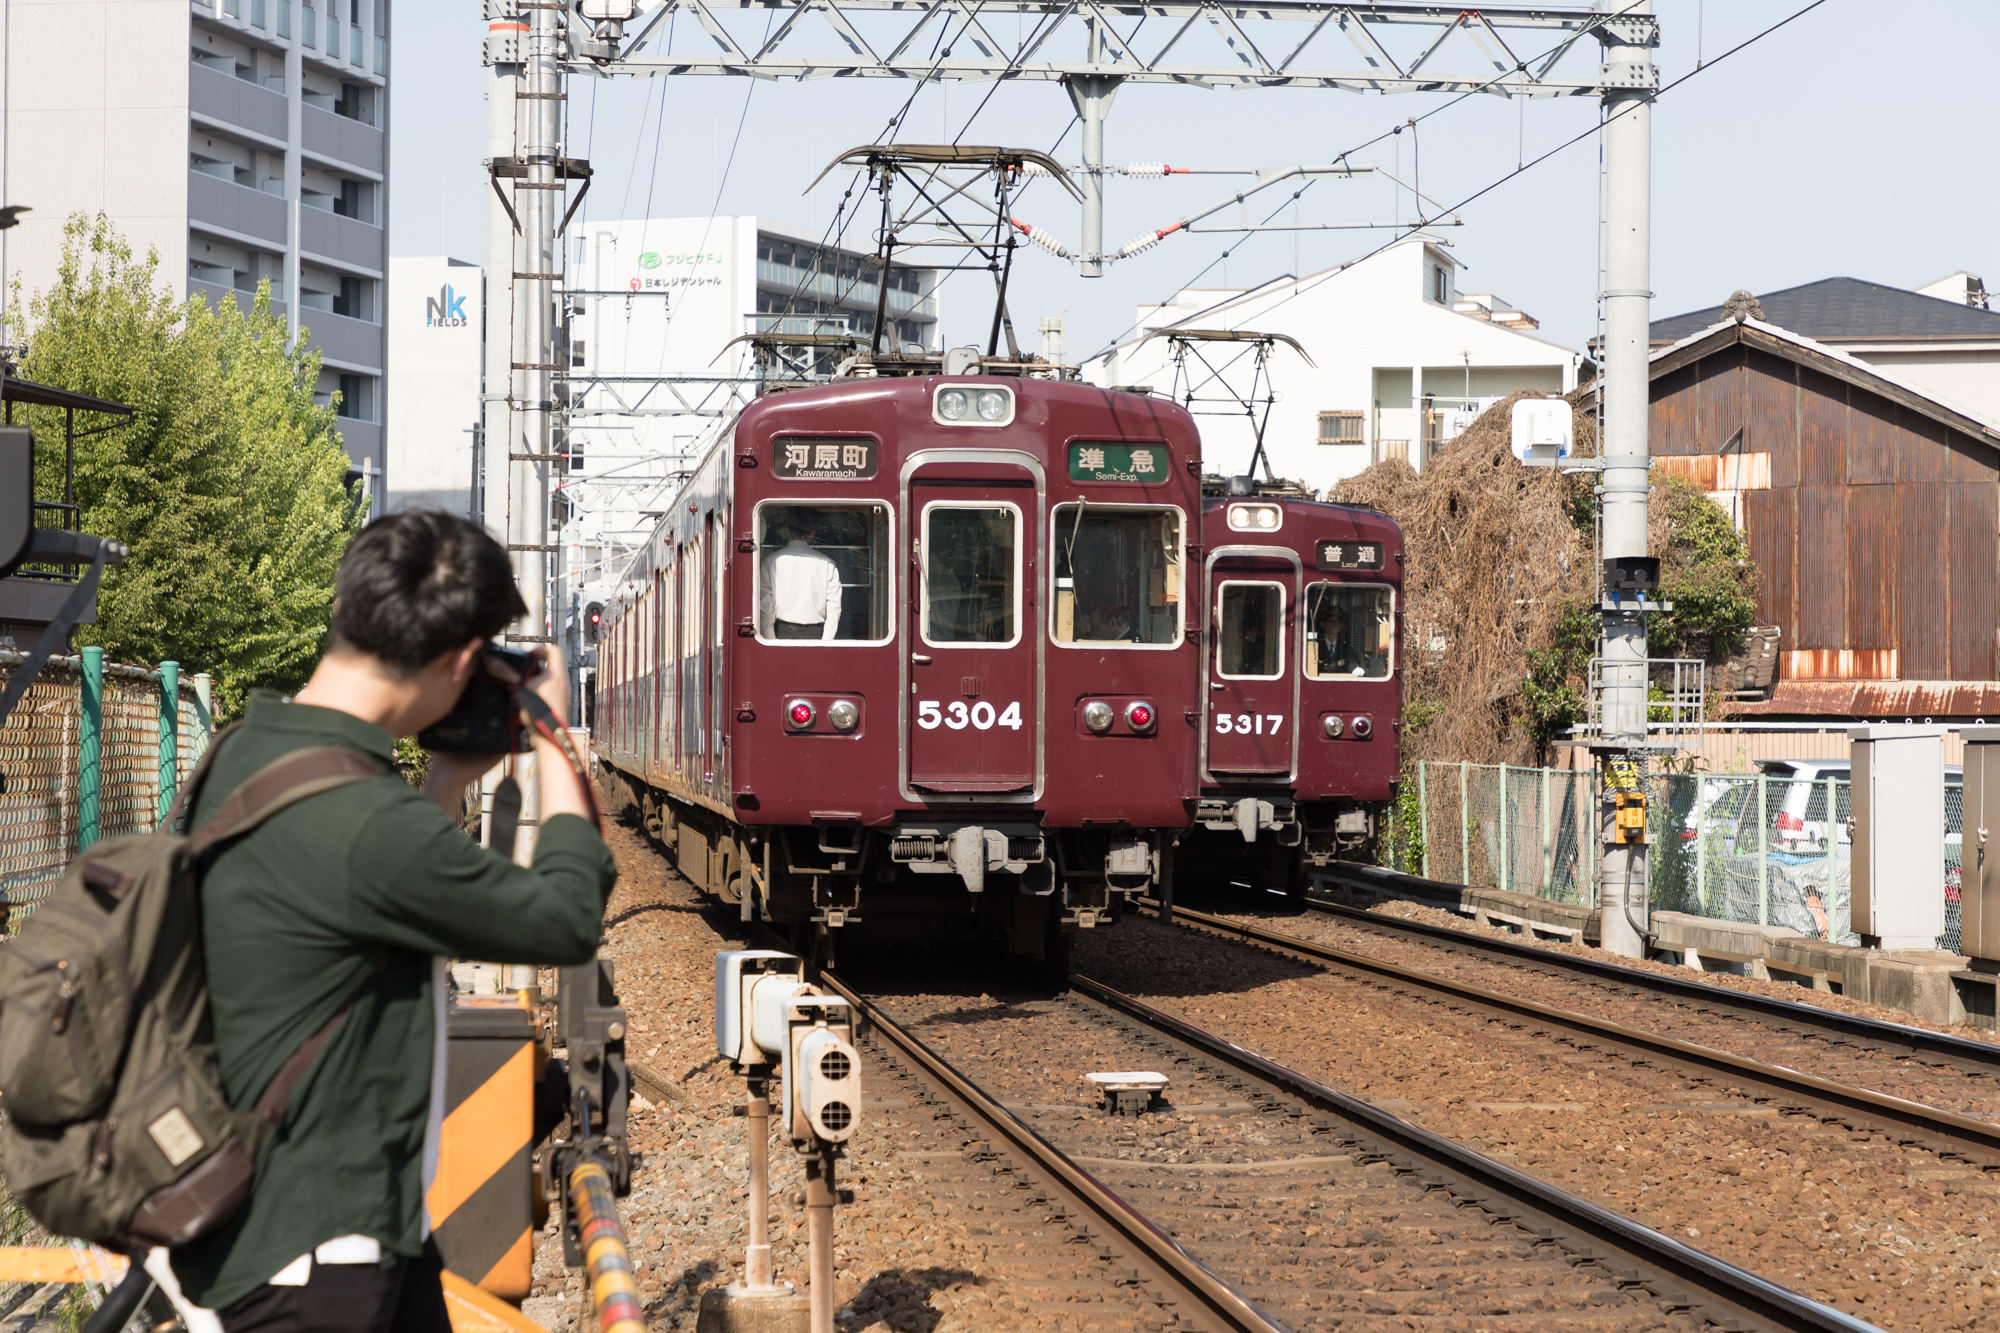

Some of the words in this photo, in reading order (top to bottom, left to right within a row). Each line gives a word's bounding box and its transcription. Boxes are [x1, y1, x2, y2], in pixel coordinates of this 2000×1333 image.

[645, 277, 721, 288] 日本レジデンシャル
[426, 317, 467, 328] FIELDS
[784, 444, 869, 469] 河原町
[1078, 447, 1156, 473] 準急
[796, 468, 857, 478] Kawaramachi
[1095, 472, 1139, 483] Semi-Exp.
[1324, 545, 1376, 563] 普通
[1341, 561, 1358, 569] Local
[917, 700, 1023, 731] 5304
[1215, 713, 1284, 736] 5317
